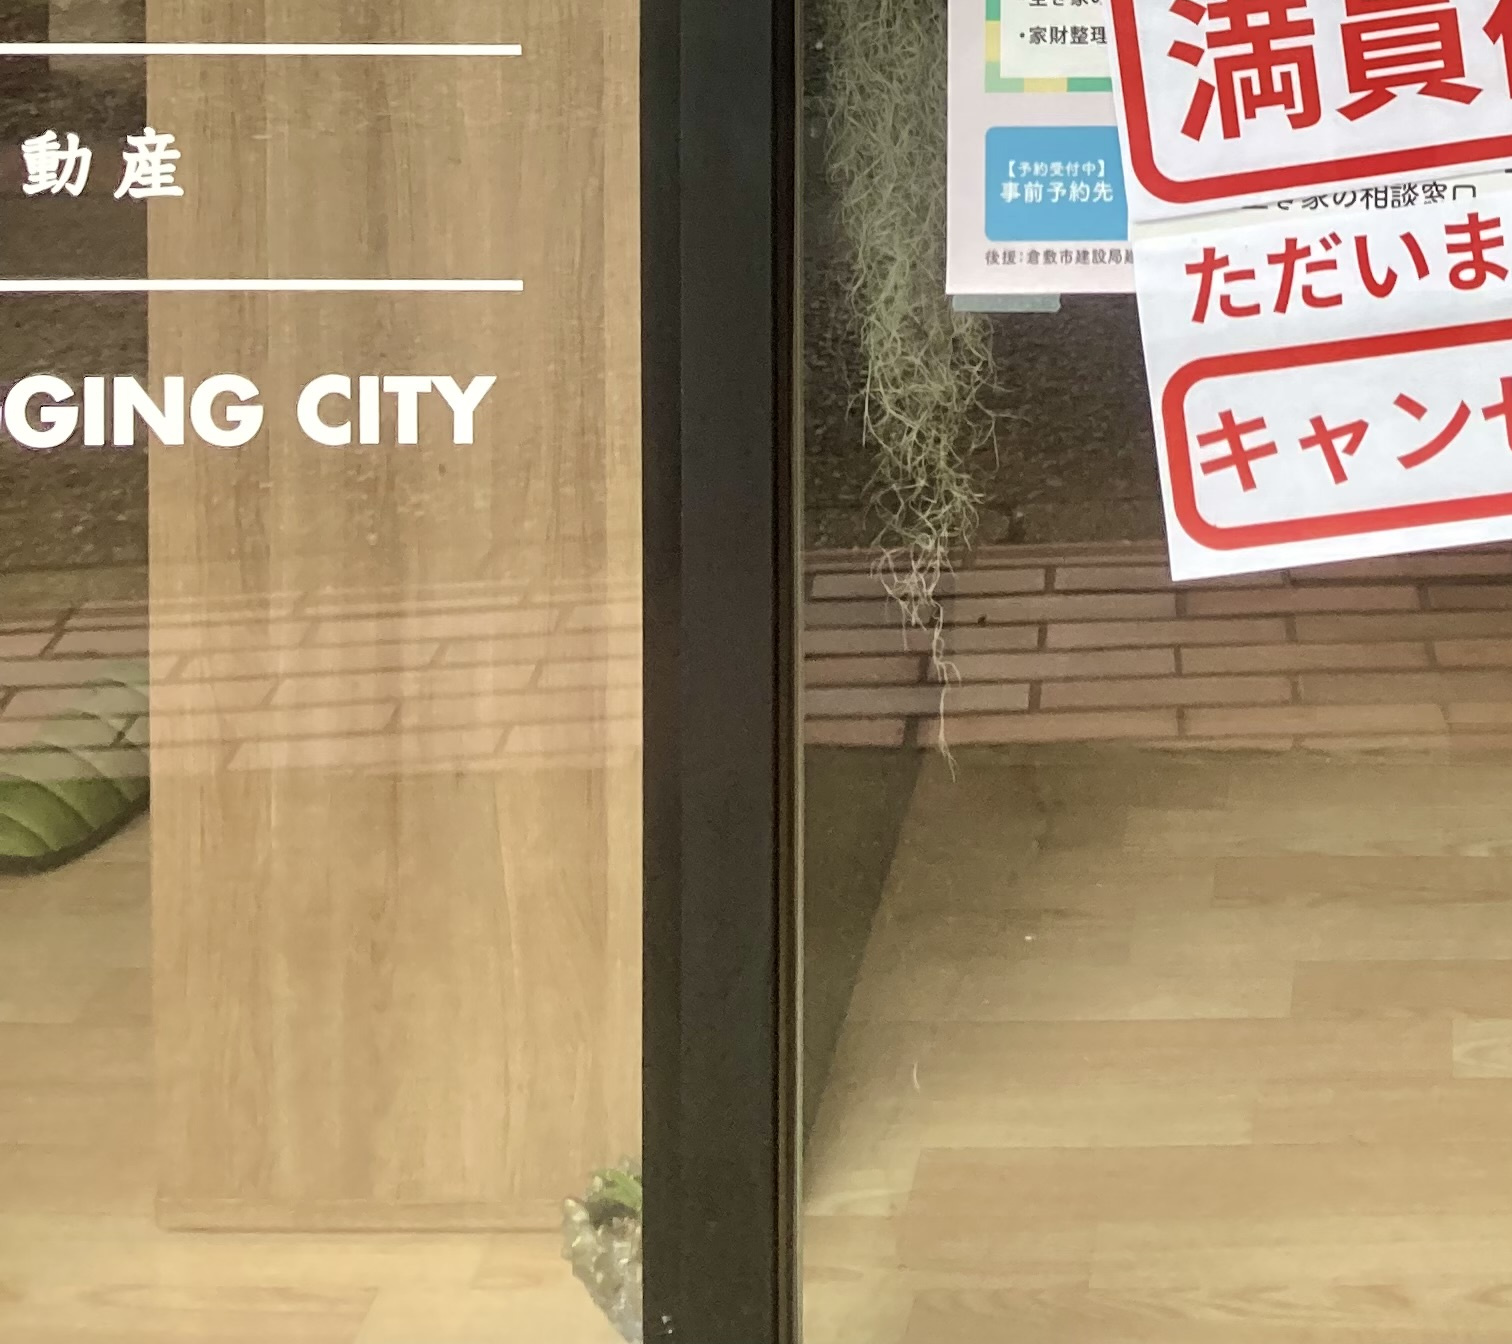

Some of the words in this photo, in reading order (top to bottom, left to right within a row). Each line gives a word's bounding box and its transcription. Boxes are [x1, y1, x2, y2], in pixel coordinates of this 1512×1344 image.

[22, 127, 185, 199] 動産
[1000, 180, 1114, 203] 事前予約先
[1008, 159, 1105, 178] 【予約受付中】
[1184, 210, 1510, 324] ただいま
[0, 374, 264, 449] GING
[296, 374, 498, 446] CITY
